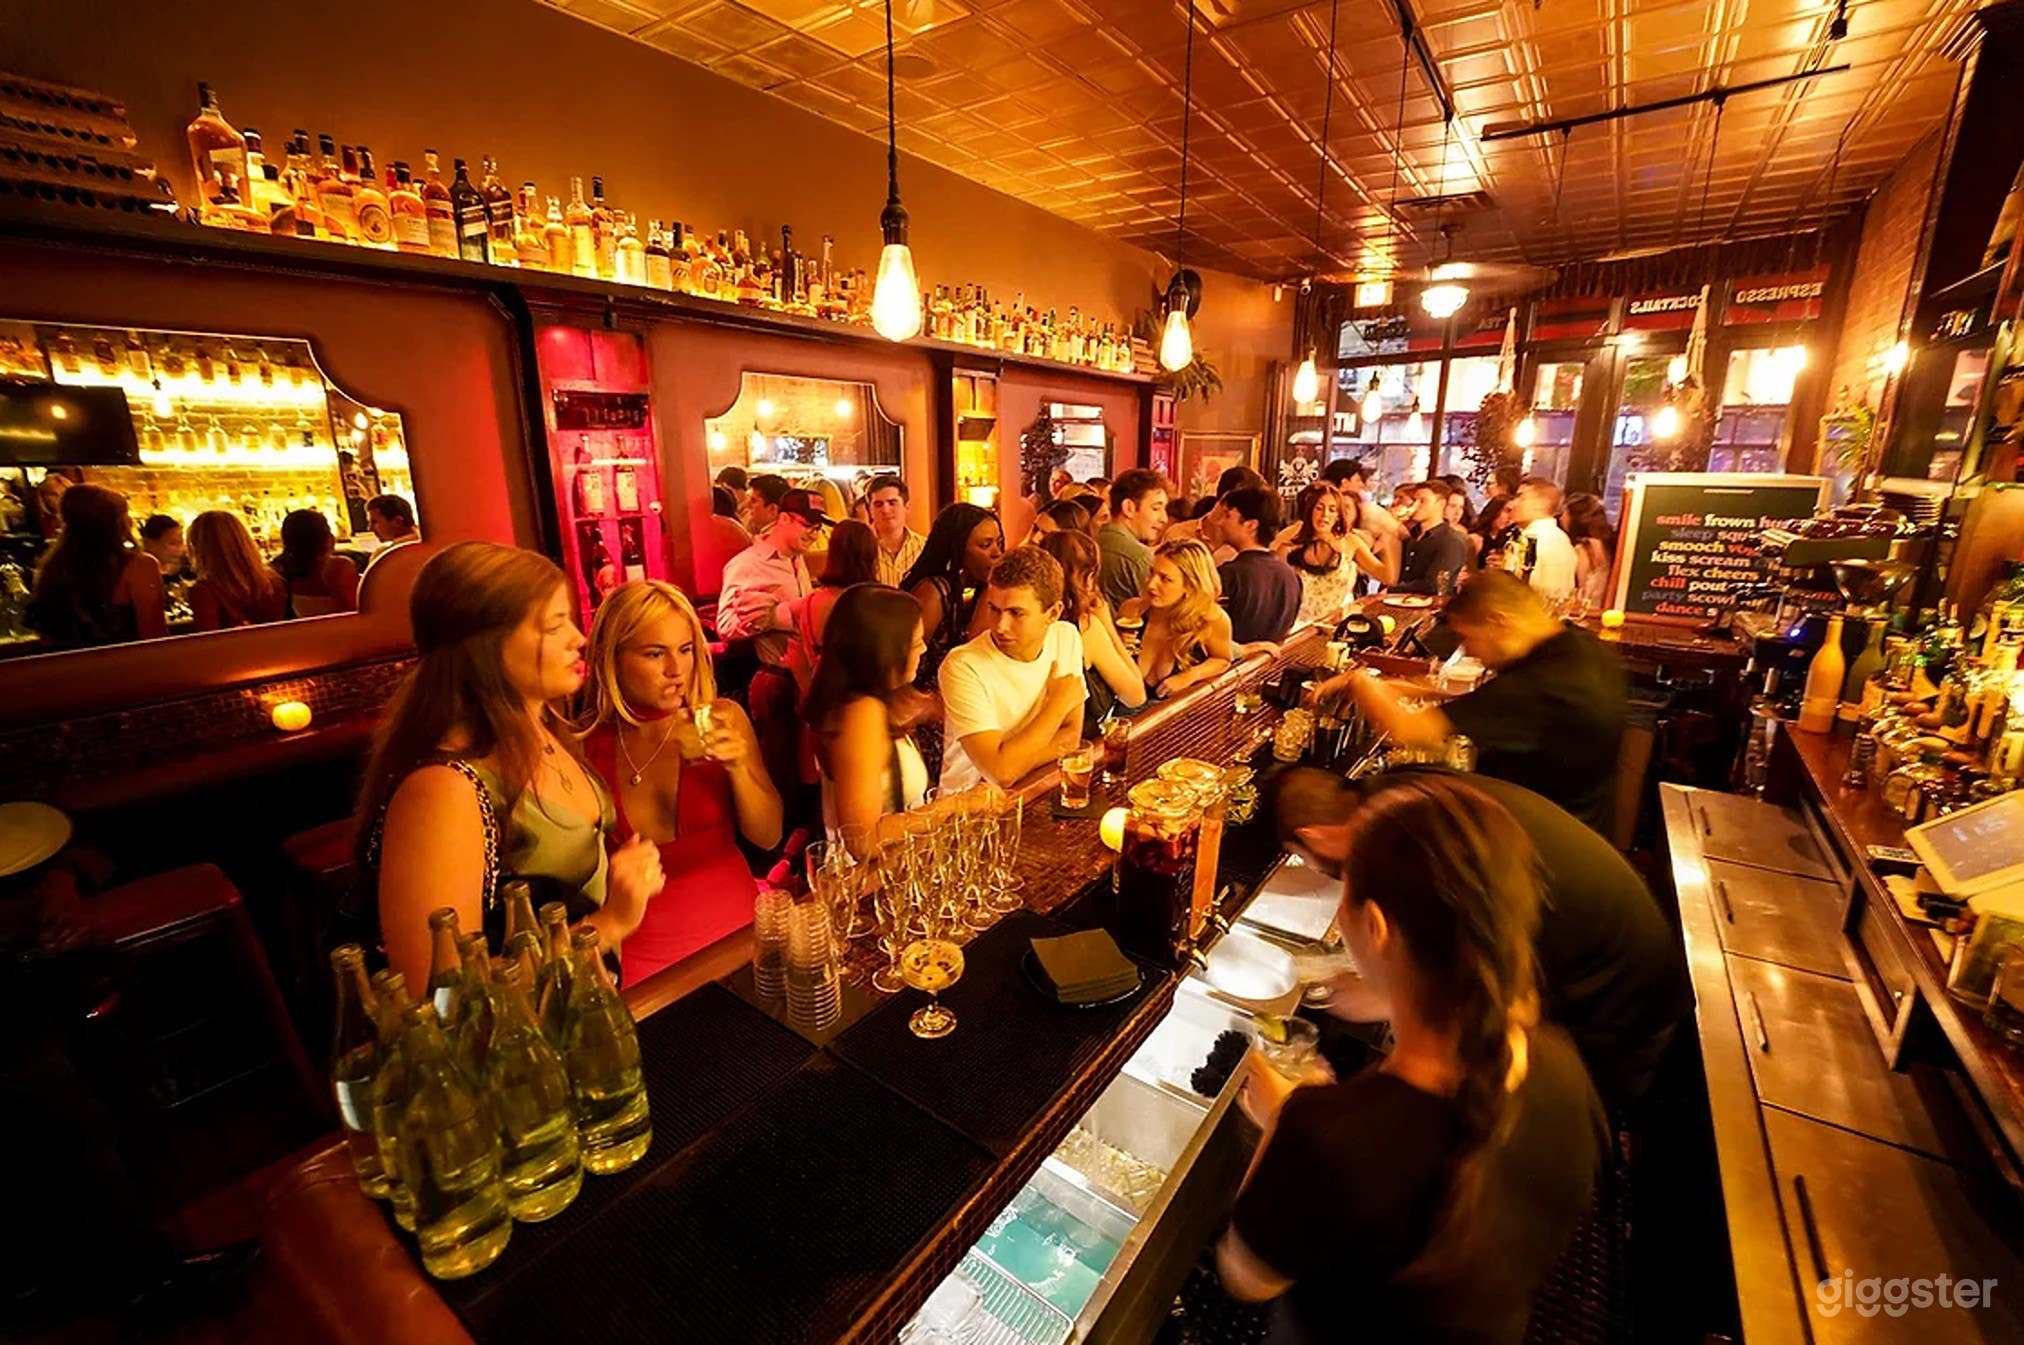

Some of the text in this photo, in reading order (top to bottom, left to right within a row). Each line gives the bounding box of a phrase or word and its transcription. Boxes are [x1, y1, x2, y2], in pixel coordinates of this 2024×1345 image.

[1656, 513, 1702, 526] smile
[1704, 514, 1756, 528] frown
[1670, 527, 1714, 541] sleep
[1659, 540, 1725, 553] smooch
[1650, 550, 1751, 567] kiss scream
[1667, 564, 1759, 581] flex cheers
[1650, 577, 1728, 592] chill pout
[1641, 590, 1685, 602] party
[1655, 601, 1704, 615] dance
